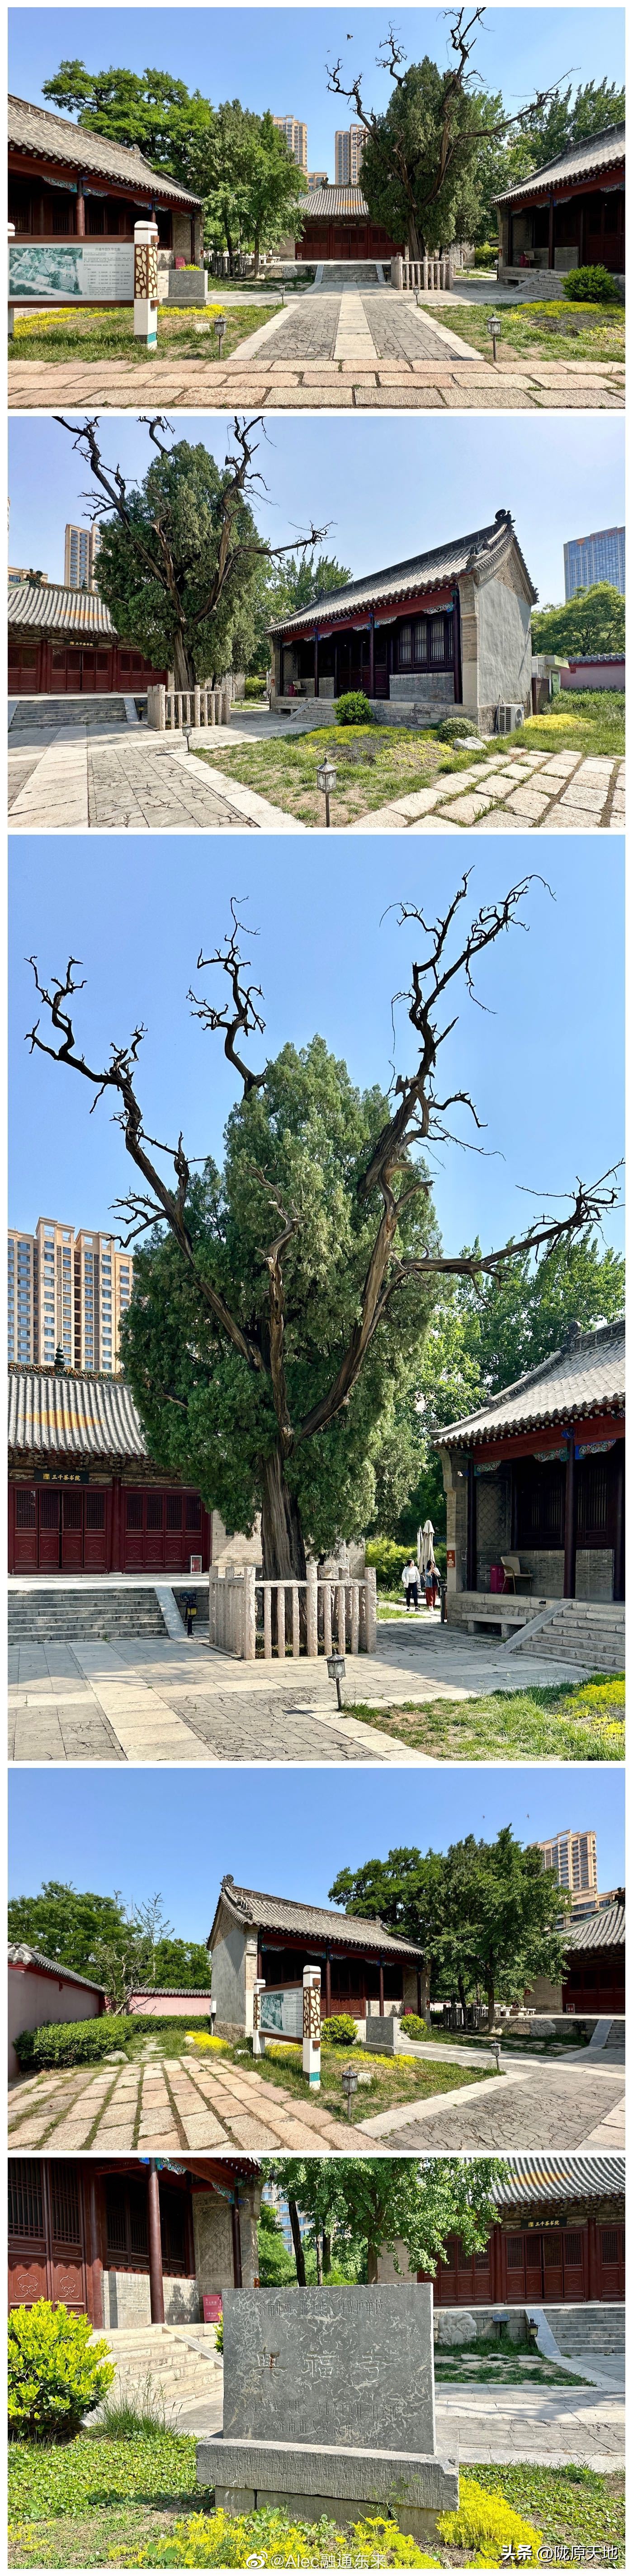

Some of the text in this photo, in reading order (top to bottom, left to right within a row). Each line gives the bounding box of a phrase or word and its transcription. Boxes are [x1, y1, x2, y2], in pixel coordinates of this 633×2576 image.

[259, 2299, 384, 2316] 济南市第一批重点文物保护单位
[275, 2418, 365, 2436] 济南市人民政府立
